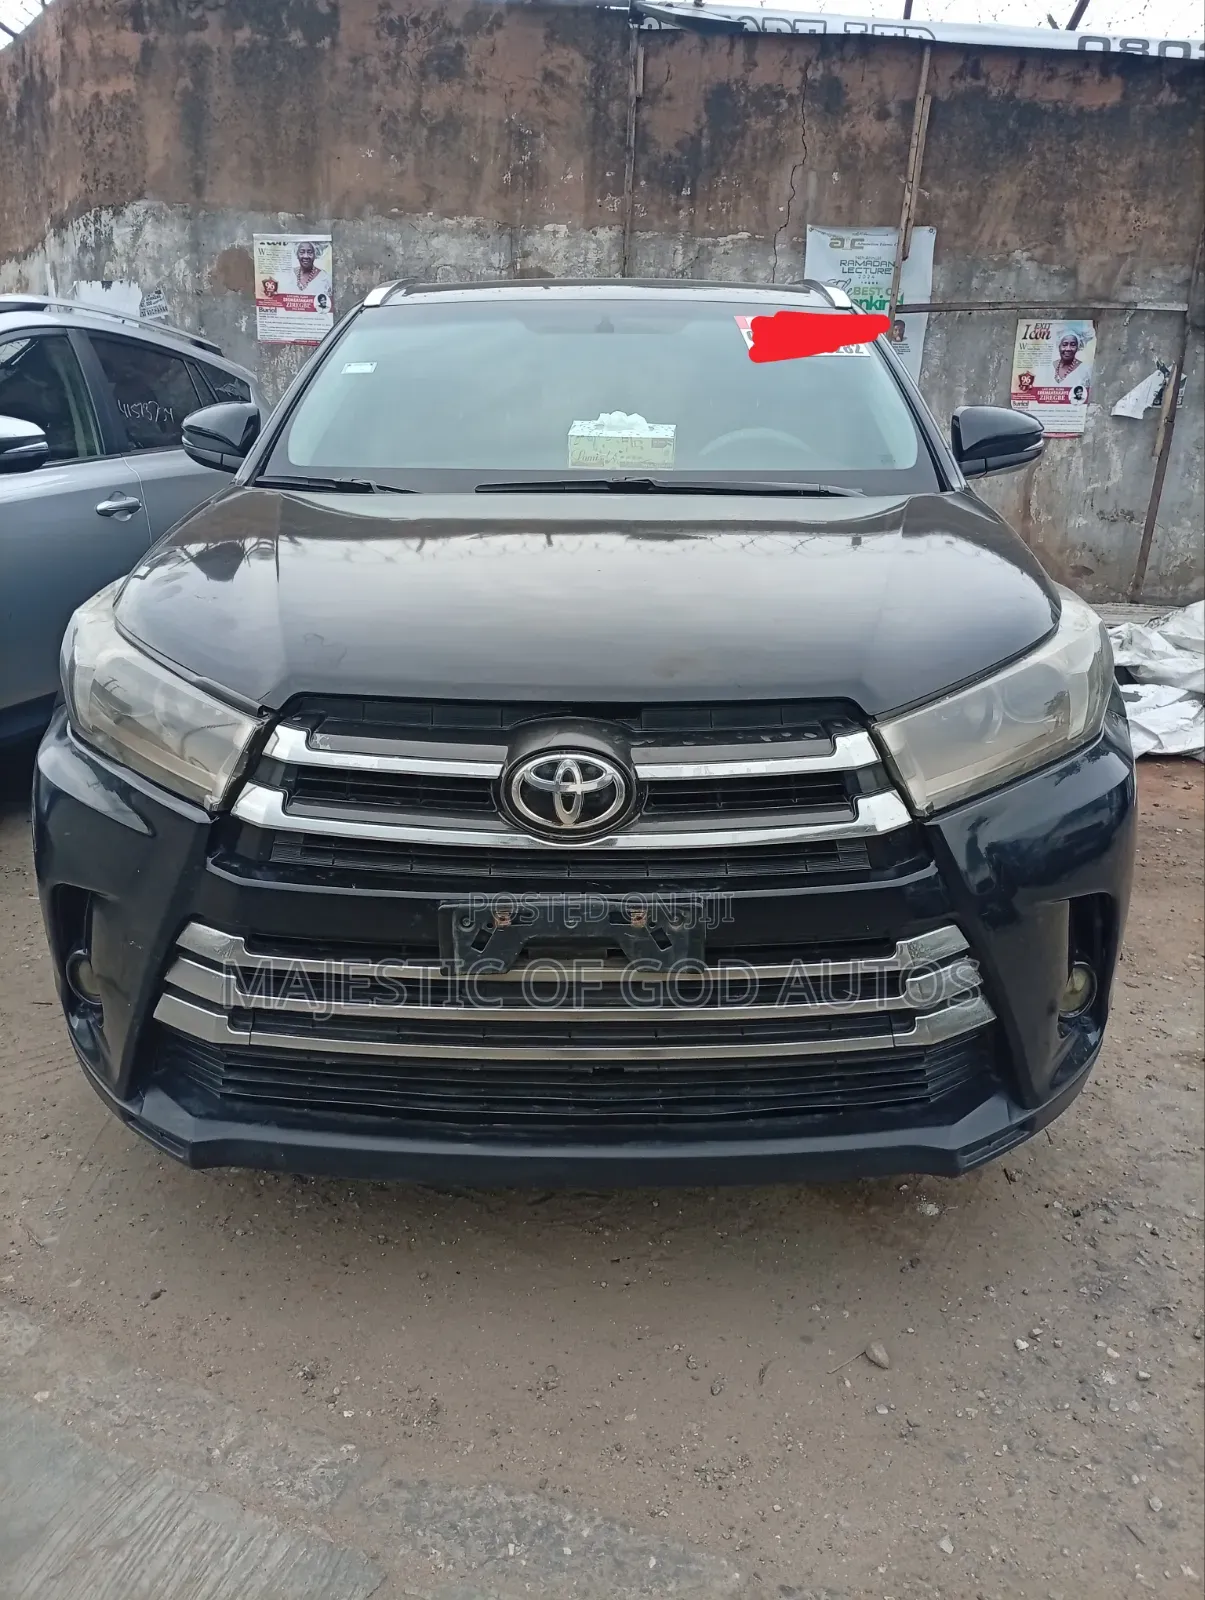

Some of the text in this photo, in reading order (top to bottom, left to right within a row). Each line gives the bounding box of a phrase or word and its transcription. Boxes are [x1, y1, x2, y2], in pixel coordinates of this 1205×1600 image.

[1078, 36, 1205, 60] 080
[842, 267, 893, 275] LECTURE
[853, 287, 883, 296] BEST
[1034, 322, 1053, 330] EXIT
[1021, 324, 1052, 341] Icon
